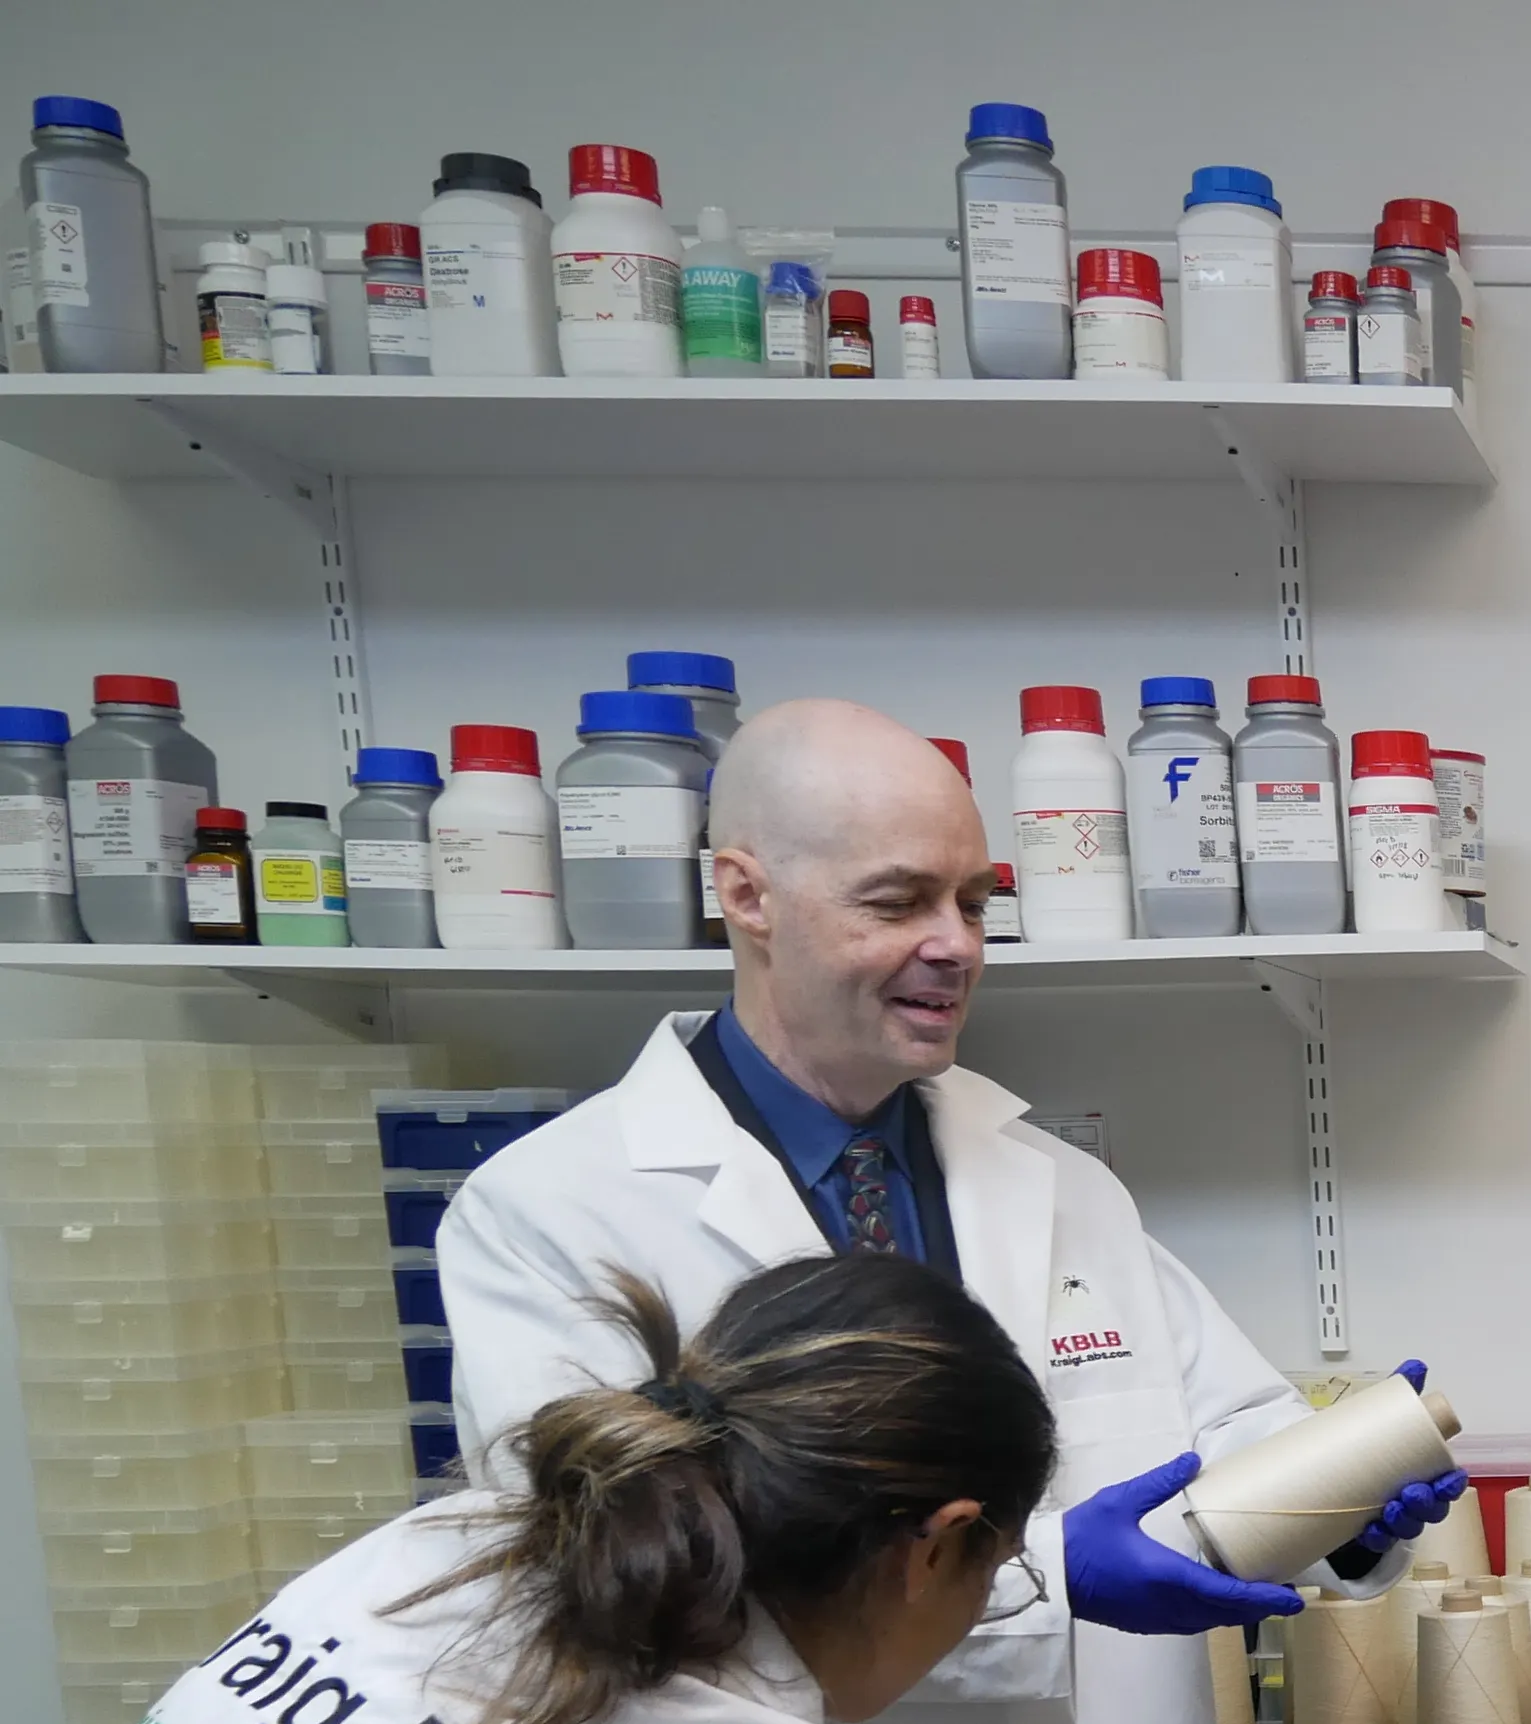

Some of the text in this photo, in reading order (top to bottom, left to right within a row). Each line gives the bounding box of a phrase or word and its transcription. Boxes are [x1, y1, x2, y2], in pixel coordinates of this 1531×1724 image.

[692, 273, 743, 288] AWAY
[384, 287, 420, 299] ACROS
[98, 783, 132, 795] ACROS
[1273, 785, 1304, 793] ACROS
[1365, 805, 1401, 814] SIGMA
[1051, 1330, 1122, 1355] KBLB
[1049, 1350, 1133, 1368] KraigLabs.com
